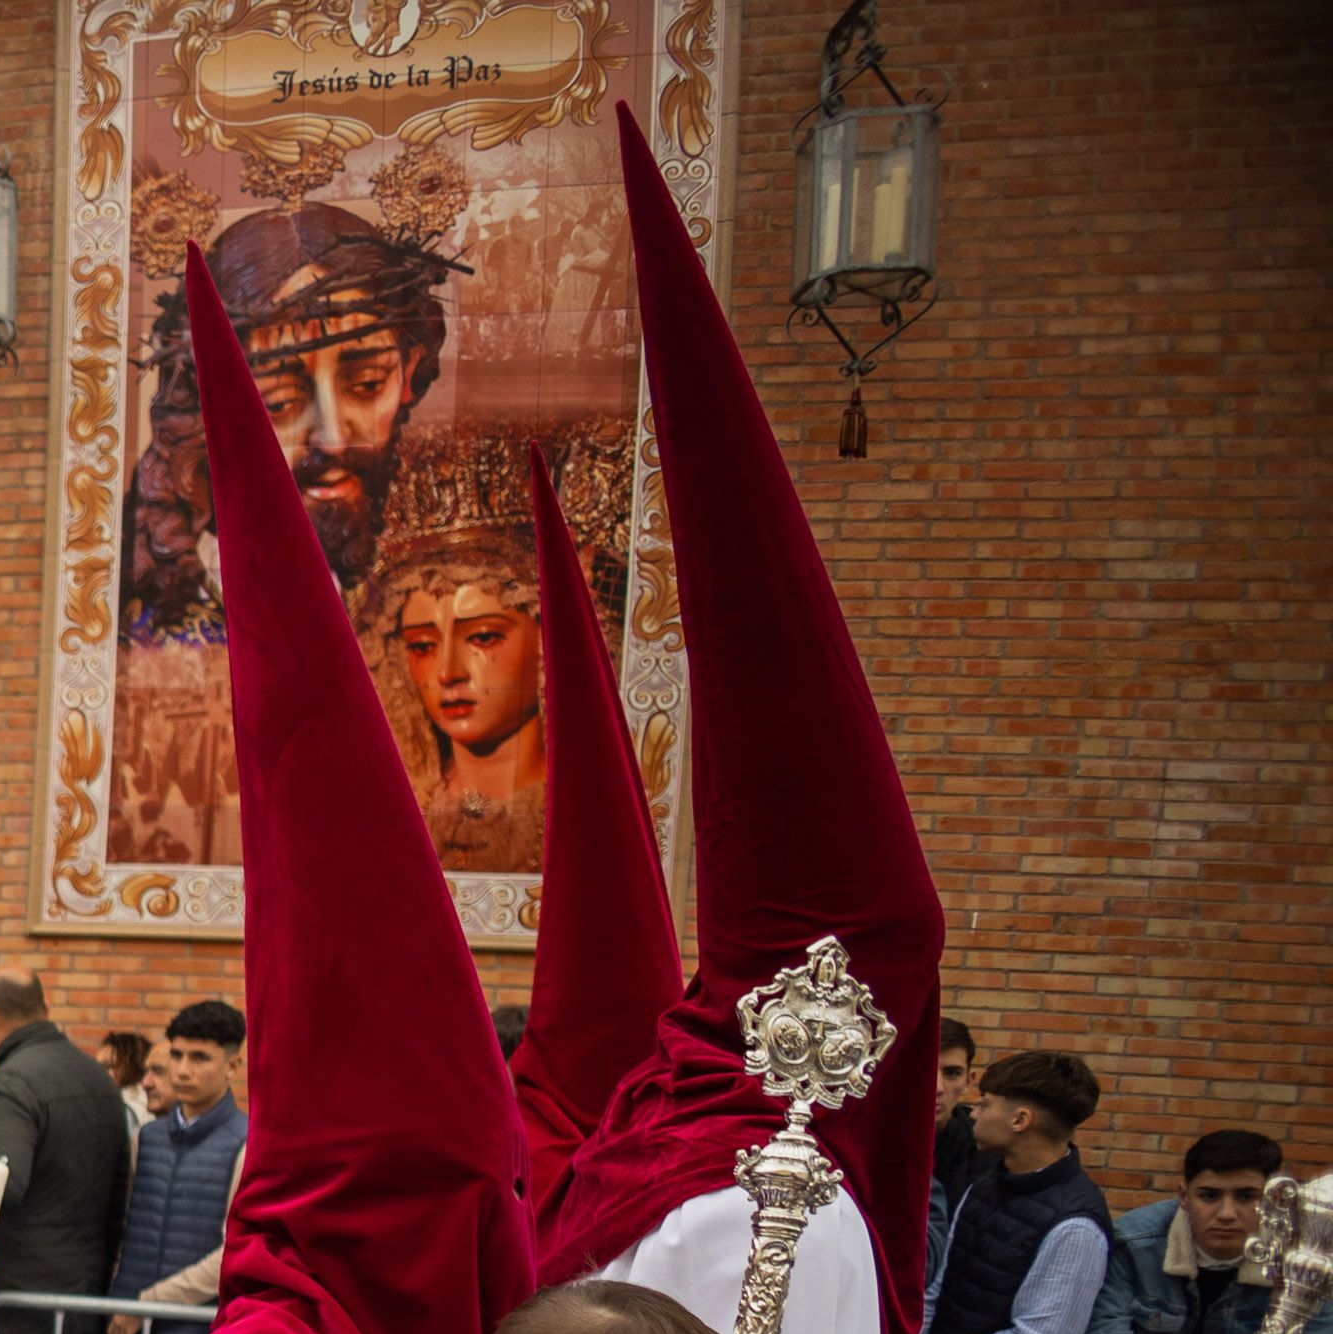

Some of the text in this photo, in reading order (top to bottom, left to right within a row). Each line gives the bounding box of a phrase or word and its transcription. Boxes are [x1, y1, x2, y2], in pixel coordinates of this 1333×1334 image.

[271, 55, 502, 104] Jesús de la Paz
